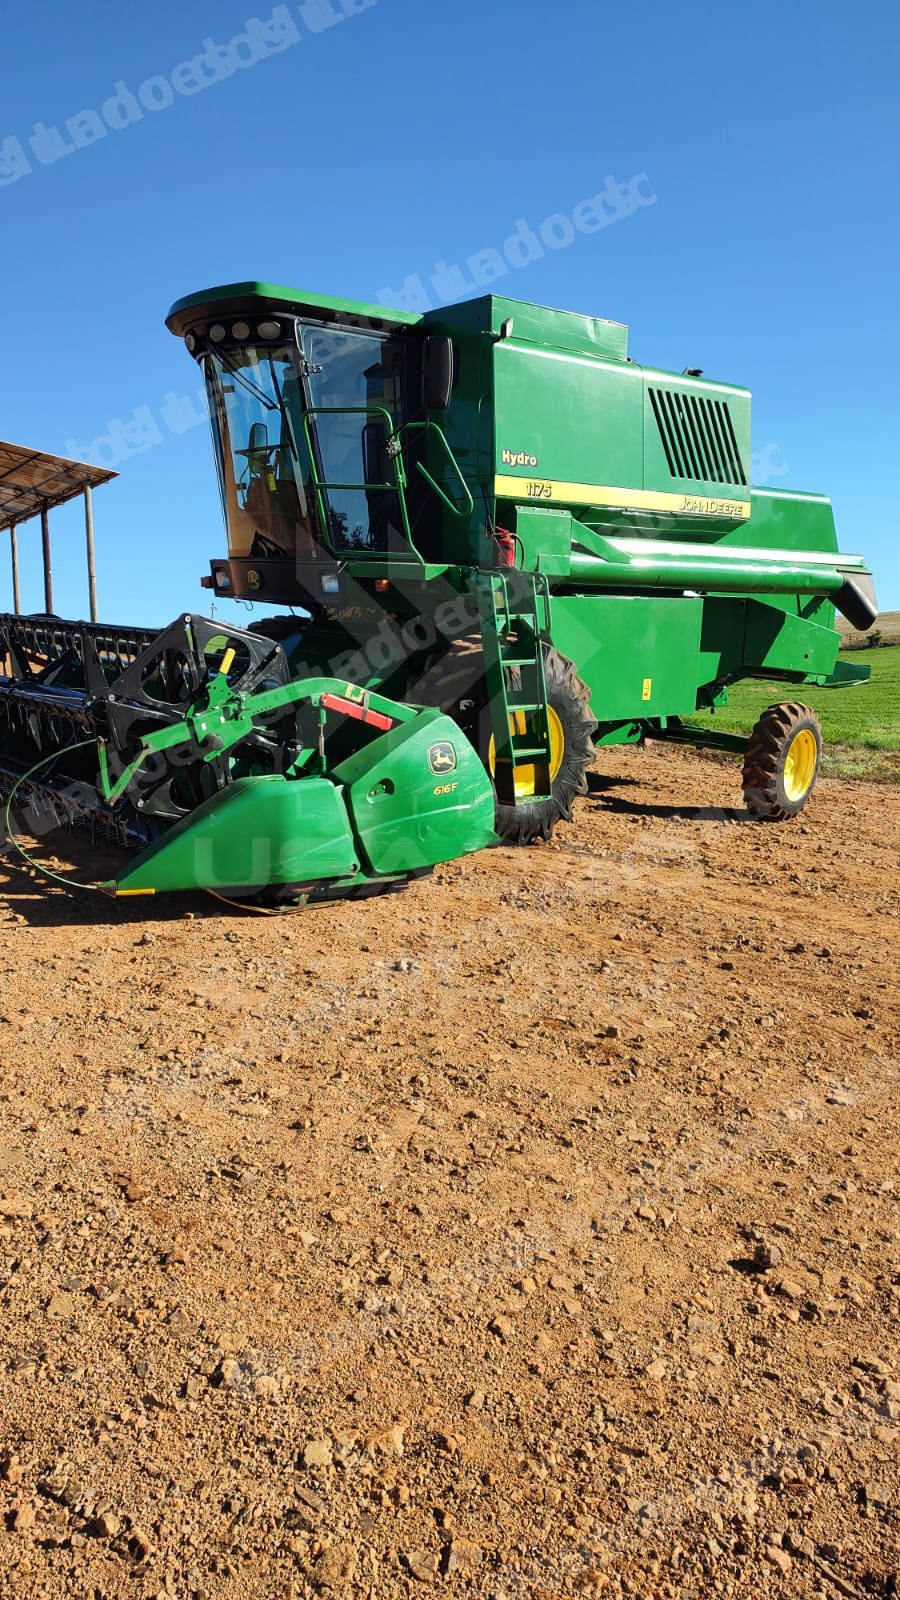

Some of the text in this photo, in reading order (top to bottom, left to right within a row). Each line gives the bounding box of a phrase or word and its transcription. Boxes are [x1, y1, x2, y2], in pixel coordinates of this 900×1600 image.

[502, 449, 538, 467] Hydro
[526, 482, 552, 498] 1175
[433, 782, 459, 798] 616F
